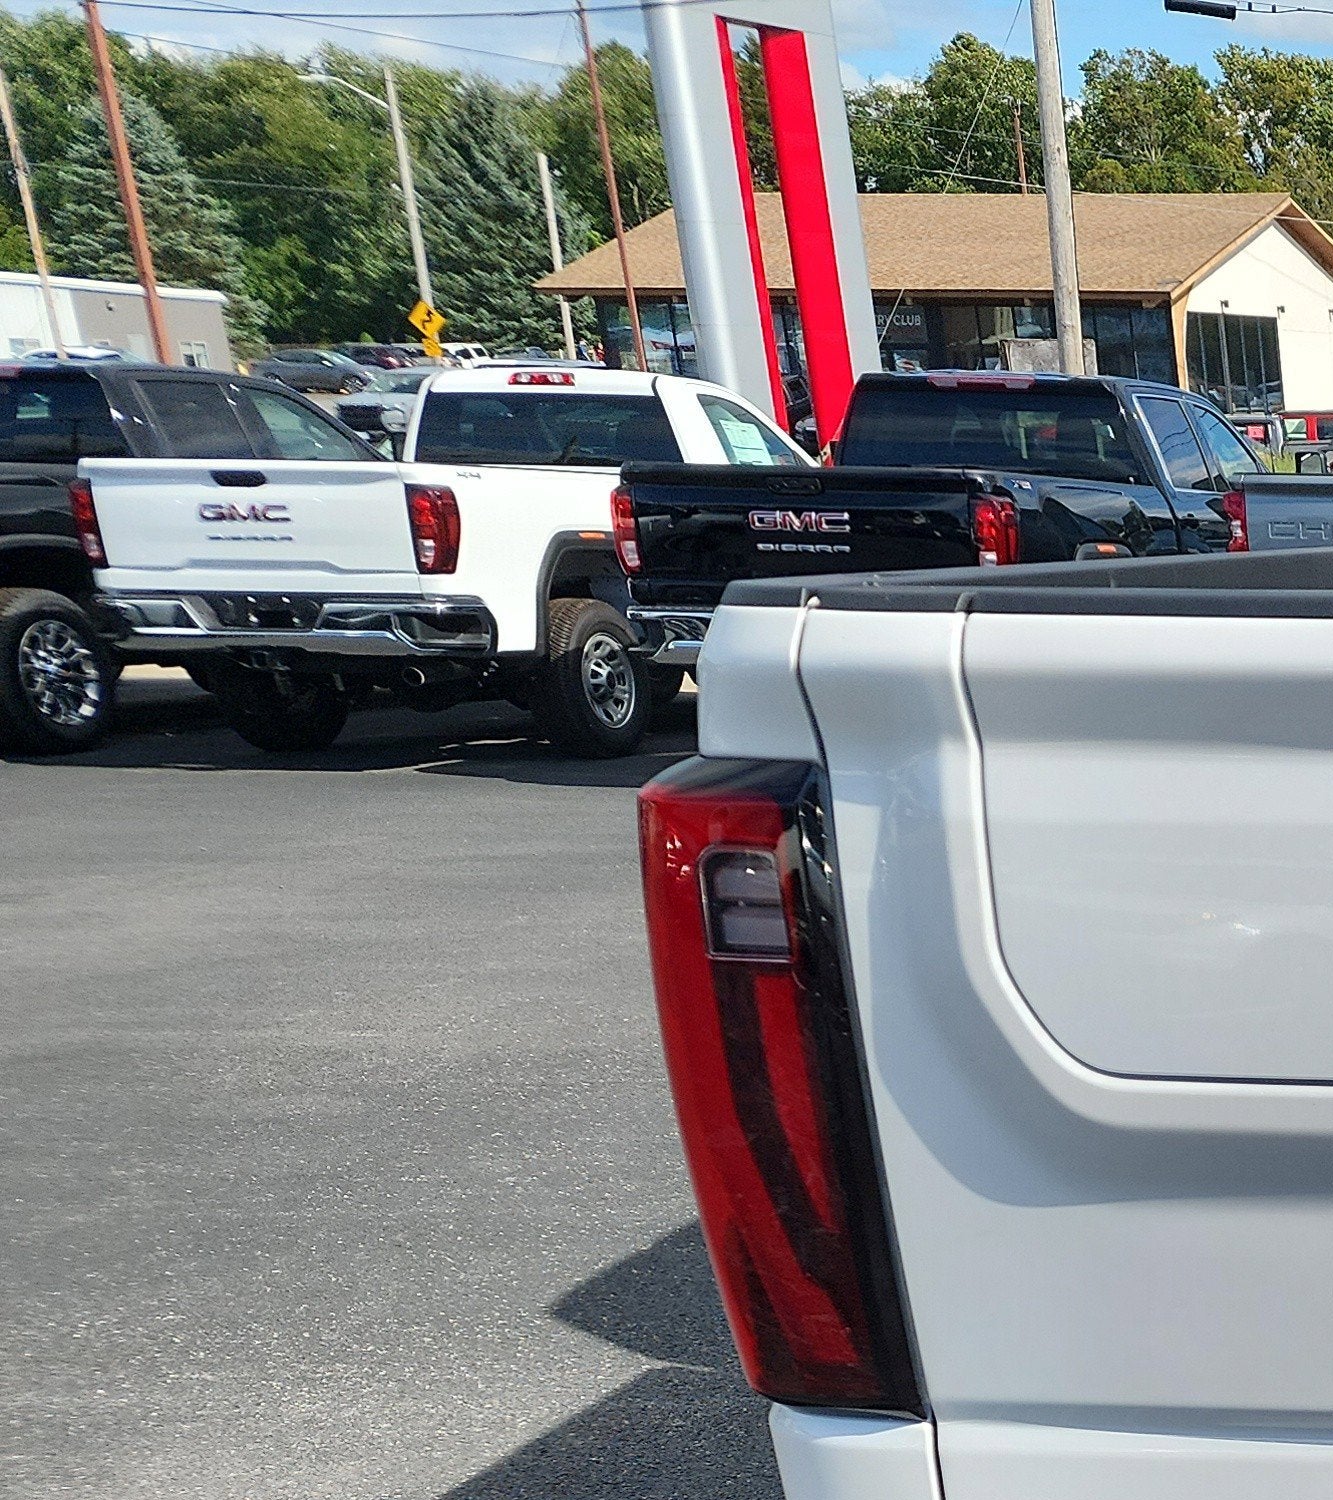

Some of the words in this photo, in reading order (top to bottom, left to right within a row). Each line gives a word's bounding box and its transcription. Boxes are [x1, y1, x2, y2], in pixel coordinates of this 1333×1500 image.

[893, 314, 921, 326] CLUB
[199, 503, 291, 522] GMC
[748, 510, 851, 533] GMC
